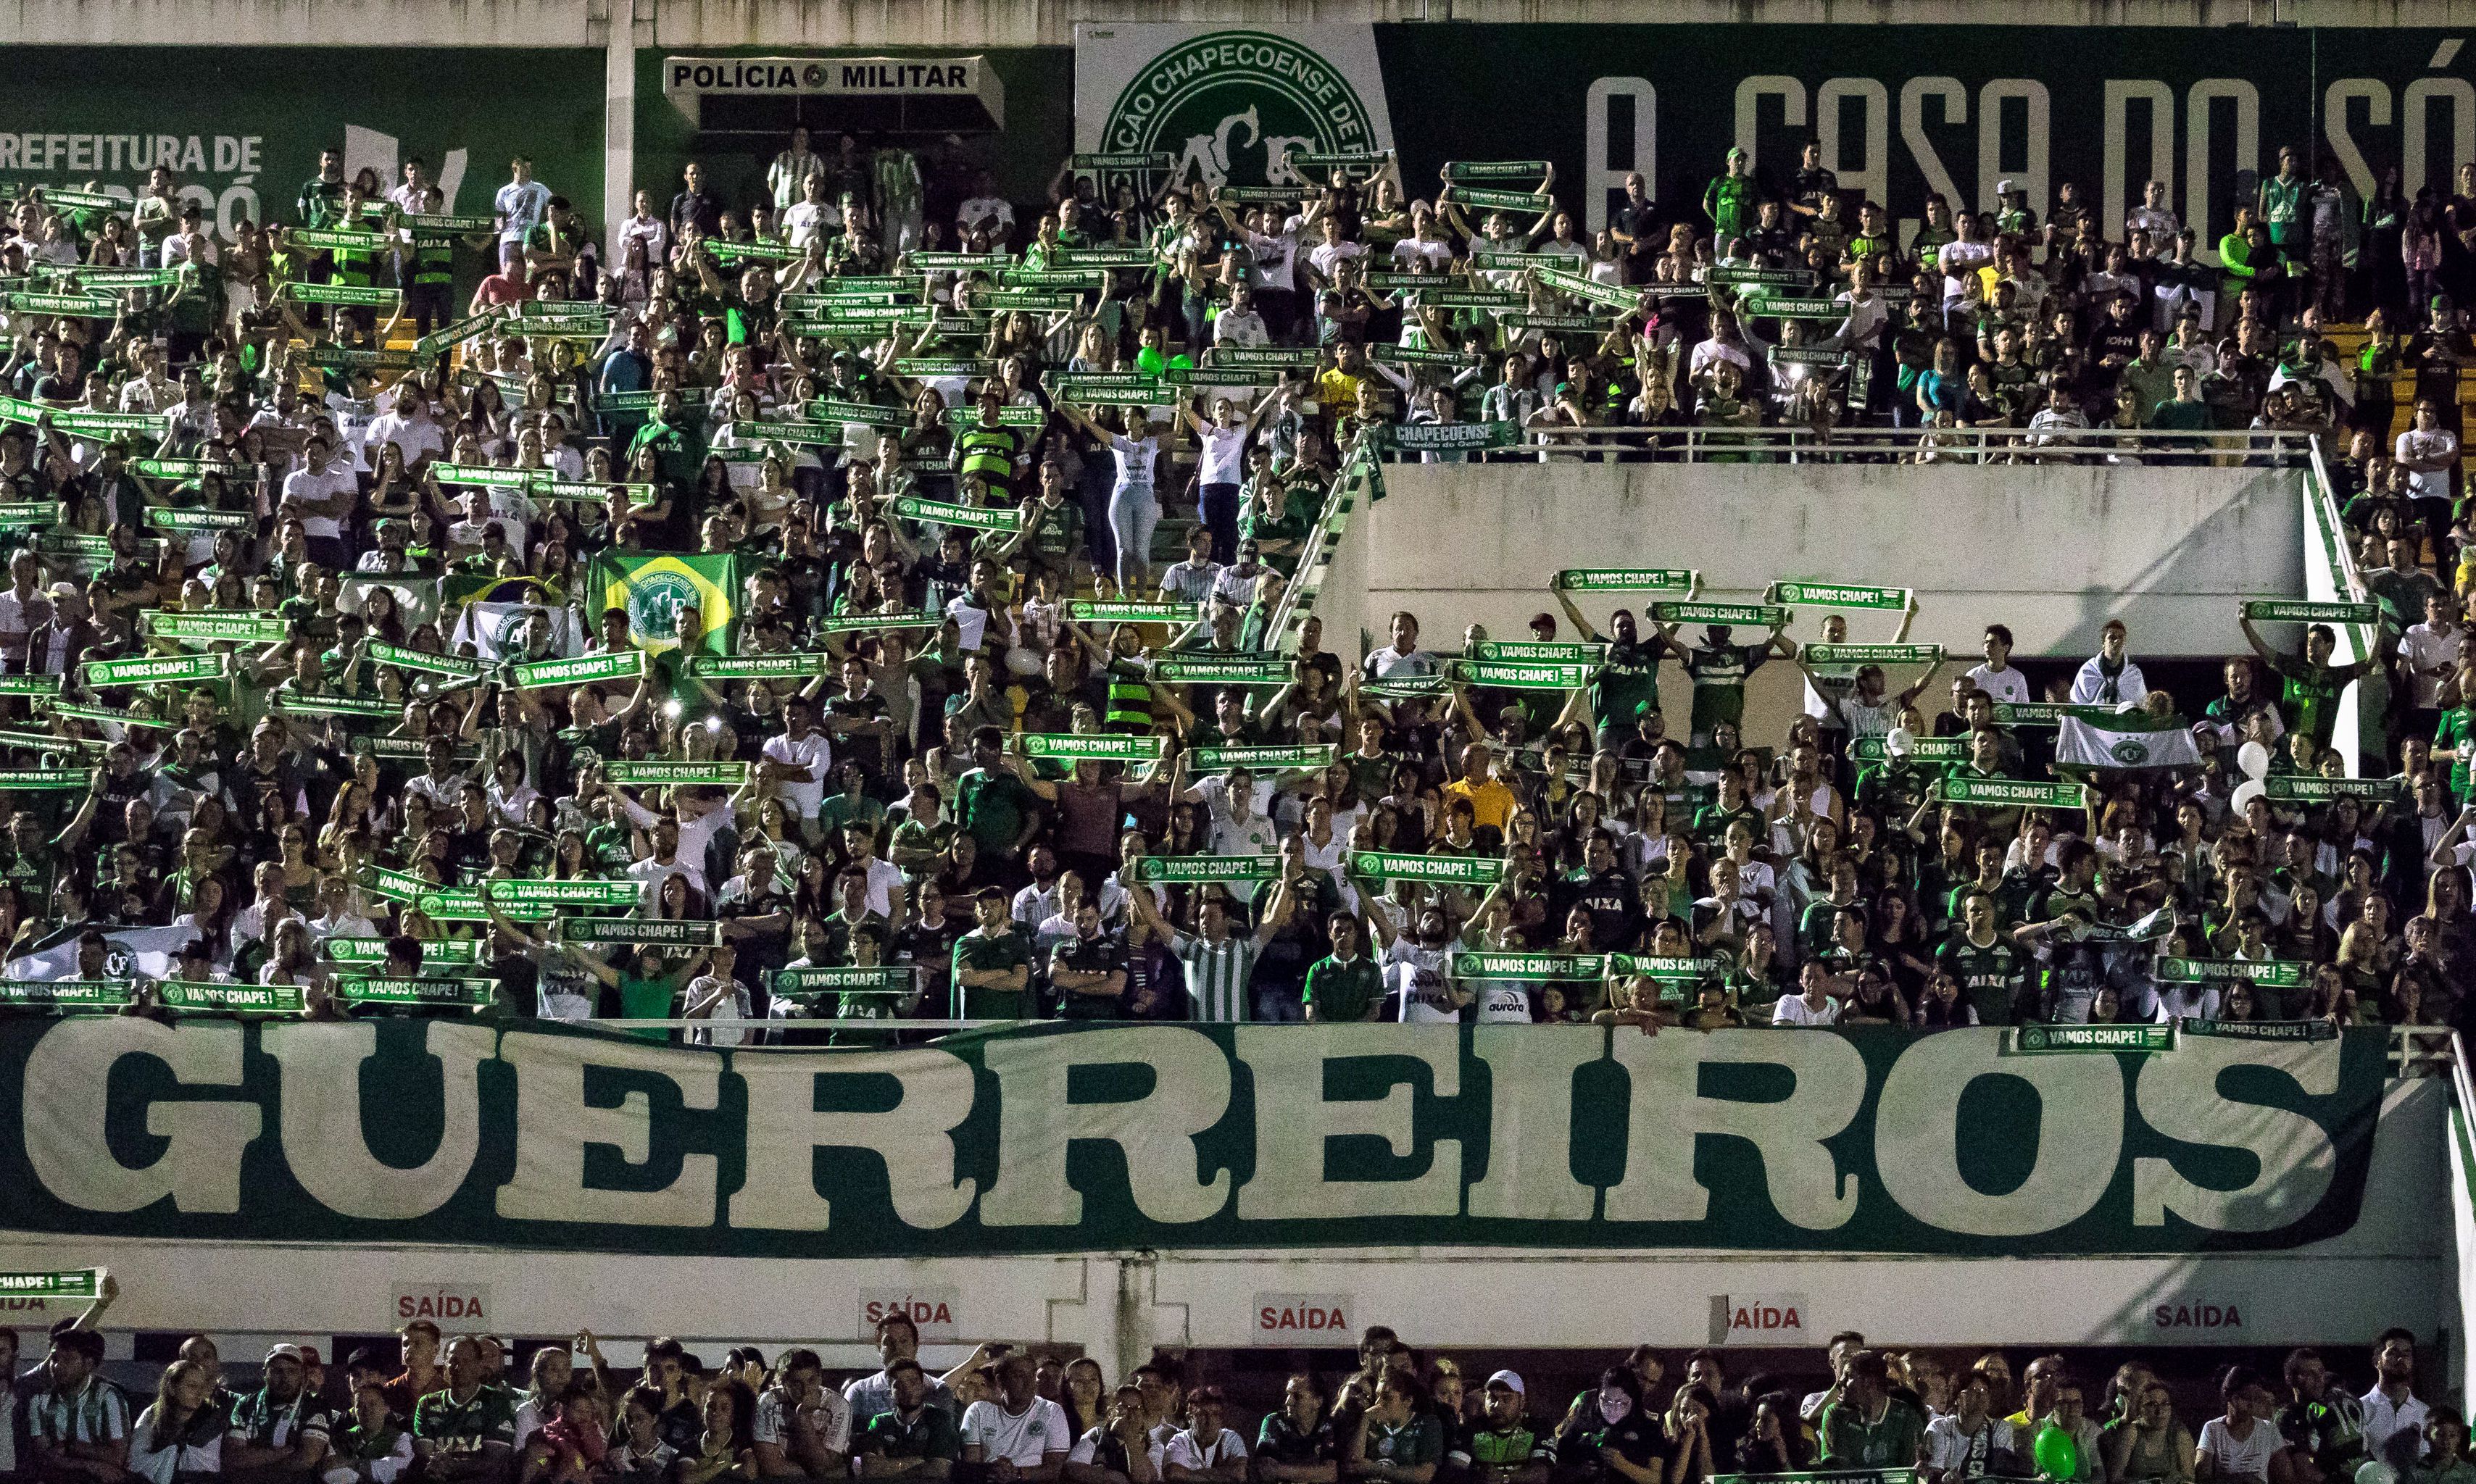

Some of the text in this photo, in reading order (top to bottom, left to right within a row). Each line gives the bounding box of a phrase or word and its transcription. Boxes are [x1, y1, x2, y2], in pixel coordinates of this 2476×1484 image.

[673, 62, 968, 88] POLÍCIA MILITAR
[1159, 44, 1360, 140] CHAPECOENSE DE
[214, 135, 262, 172] DE
[1495, 256, 1558, 267] VAMOS CHAPE!
[1766, 301, 1829, 313] VAMOS CHAPE!
[1234, 351, 1300, 362] VAMOS CHAPE!
[1087, 390, 1152, 400] VAMOS CHAPE!
[174, 513, 206, 525] VAMOS
[920, 504, 994, 522] VAMOS CHAPE!
[1586, 572, 1664, 585] VAMOS CHAPE!
[1803, 588, 1879, 603] VAMOS CHAPE!
[1094, 604, 1172, 616] VAMOS CHAPE!
[1679, 605, 1758, 620] VAMOS CHAPE!
[2273, 606, 2351, 617] VAMOS CHAPE!
[177, 620, 256, 635] VAMOS CHAPE!
[1501, 645, 1578, 659] VAMOS CHAPE!
[1833, 647, 1913, 659] VAMOS CHAPE!
[394, 649, 473, 670] VAMOS CHAPE!
[718, 660, 797, 670] VAMOS CHAPE!
[112, 660, 194, 677] VAMOS CHAPE!
[533, 660, 612, 680] VAMOS CHAPE!
[1184, 665, 1263, 678] VAMOS CHAPE!
[1480, 667, 1559, 683] VAMOS CHAPE!
[2015, 708, 2053, 719] VAMOS
[1049, 739, 1131, 753] VAMOS CHAPE!
[1220, 750, 1300, 762] VAMOS CHAPE!
[632, 767, 716, 778] VAMOS CHAPE!
[1970, 784, 2053, 799] VAMOS CHAPE!
[2292, 783, 2373, 795] VAMOS CHAPE!
[1166, 861, 1252, 875] VAMOS CHAPE!
[1384, 859, 1471, 875] VAMOS CHAPE!
[378, 874, 417, 898] VAMOS
[517, 885, 607, 899] VAMOS CHAPE!
[595, 924, 684, 938] VAMOS CHAPE!
[1484, 959, 1573, 973] VAMOS CHAPE!
[1634, 957, 1676, 970] VAMOS
[2188, 962, 2276, 978] VAMOS CHAPE!
[802, 972, 886, 986] VAMOS CHAPE!
[9, 984, 99, 997] VAMOS CHAPE!
[368, 980, 458, 996] VAMOS CHAPE!
[226, 990, 273, 1004] CHAPE!
[1489, 1001, 1524, 1012] aurora
[2050, 1030, 2143, 1043] VAMOS CHAPE!
[2214, 1022, 2306, 1037] VAMOS CHAPE!
[22, 1016, 2340, 1237] GUERREIROS
[398, 1291, 483, 1319] SAÍDA
[1260, 1301, 1347, 1330] SAÍDA
[1727, 1301, 1800, 1329] AÍDA
[2155, 1301, 2242, 1328] SAÍDA
